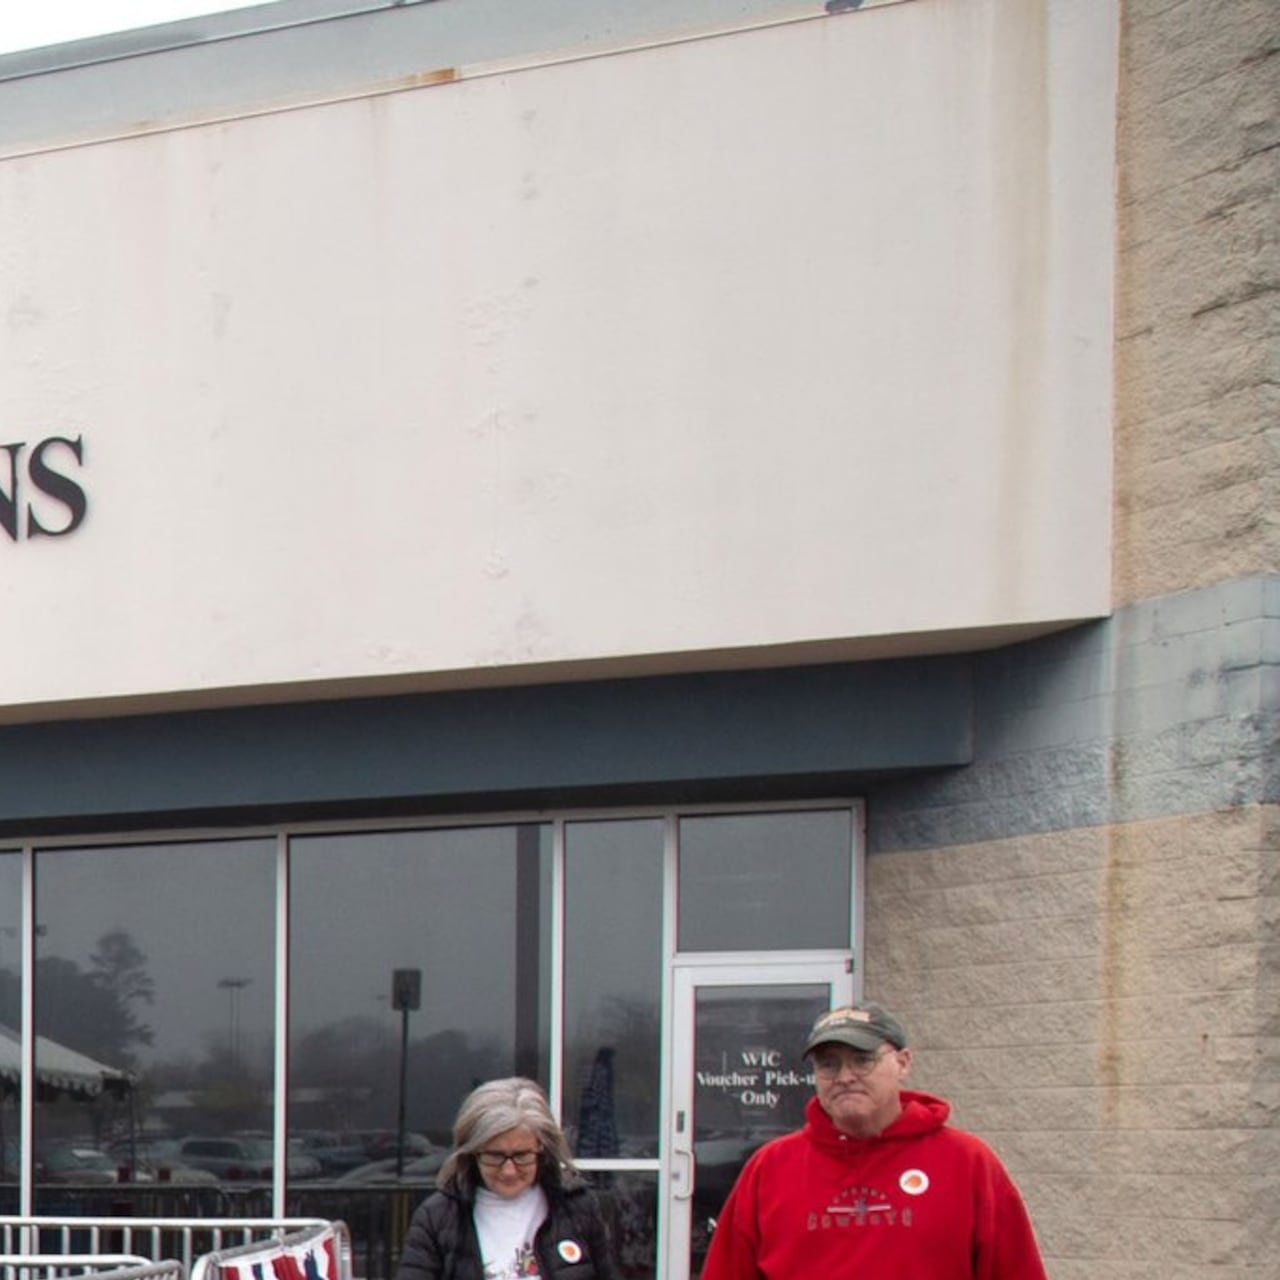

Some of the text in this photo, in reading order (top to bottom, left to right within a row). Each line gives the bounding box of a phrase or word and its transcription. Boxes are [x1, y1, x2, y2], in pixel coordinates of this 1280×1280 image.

[741, 1052, 781, 1066] WIC
[697, 1070, 816, 1086] Voucher Pick-u
[741, 1090, 780, 1108] Only
